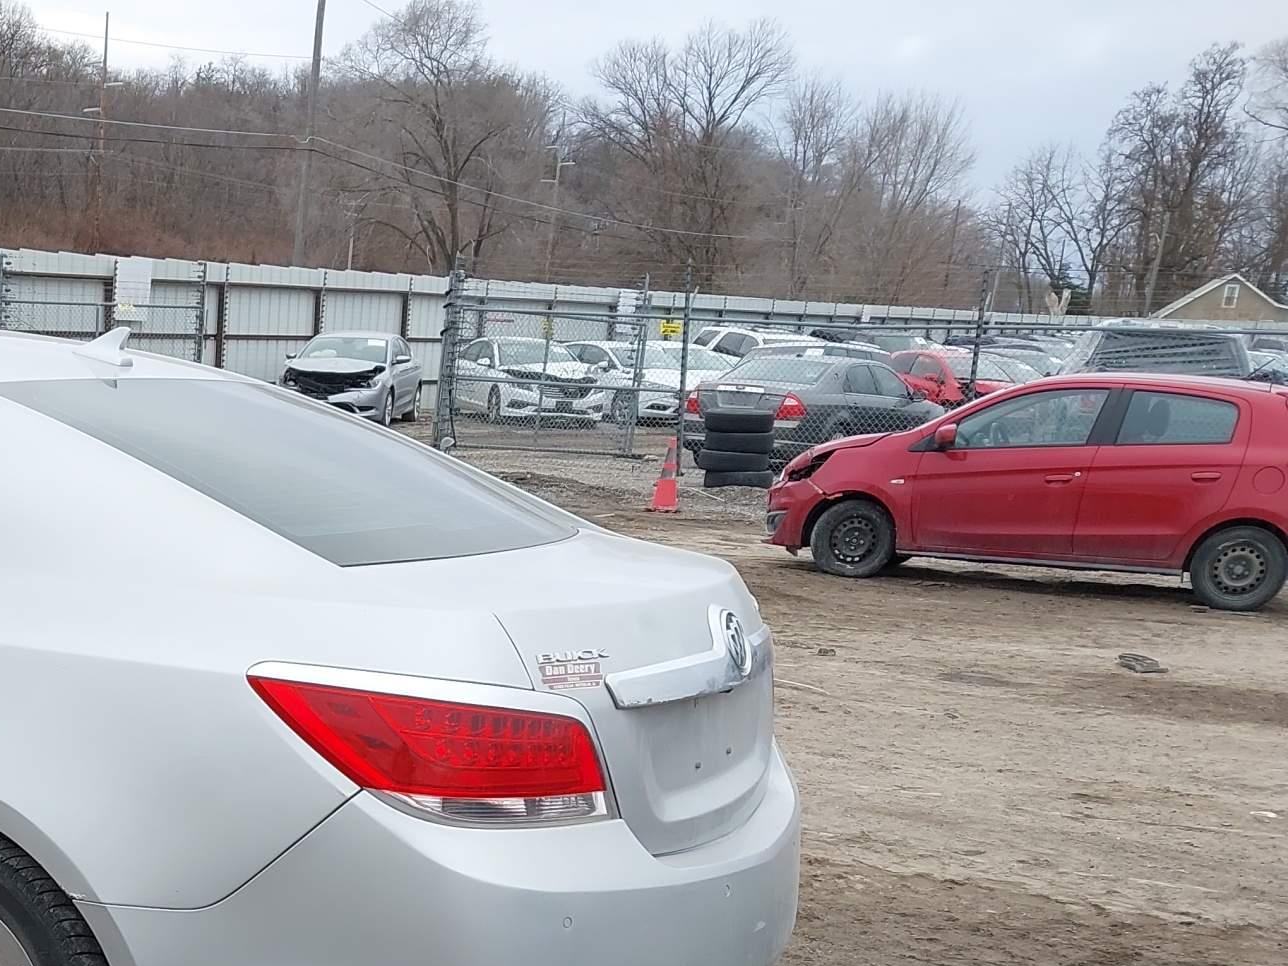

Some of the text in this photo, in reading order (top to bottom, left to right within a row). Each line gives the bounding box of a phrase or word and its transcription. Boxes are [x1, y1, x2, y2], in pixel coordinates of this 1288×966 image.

[536, 649, 610, 664] BUICK
[545, 662, 595, 676] Dan Deery
